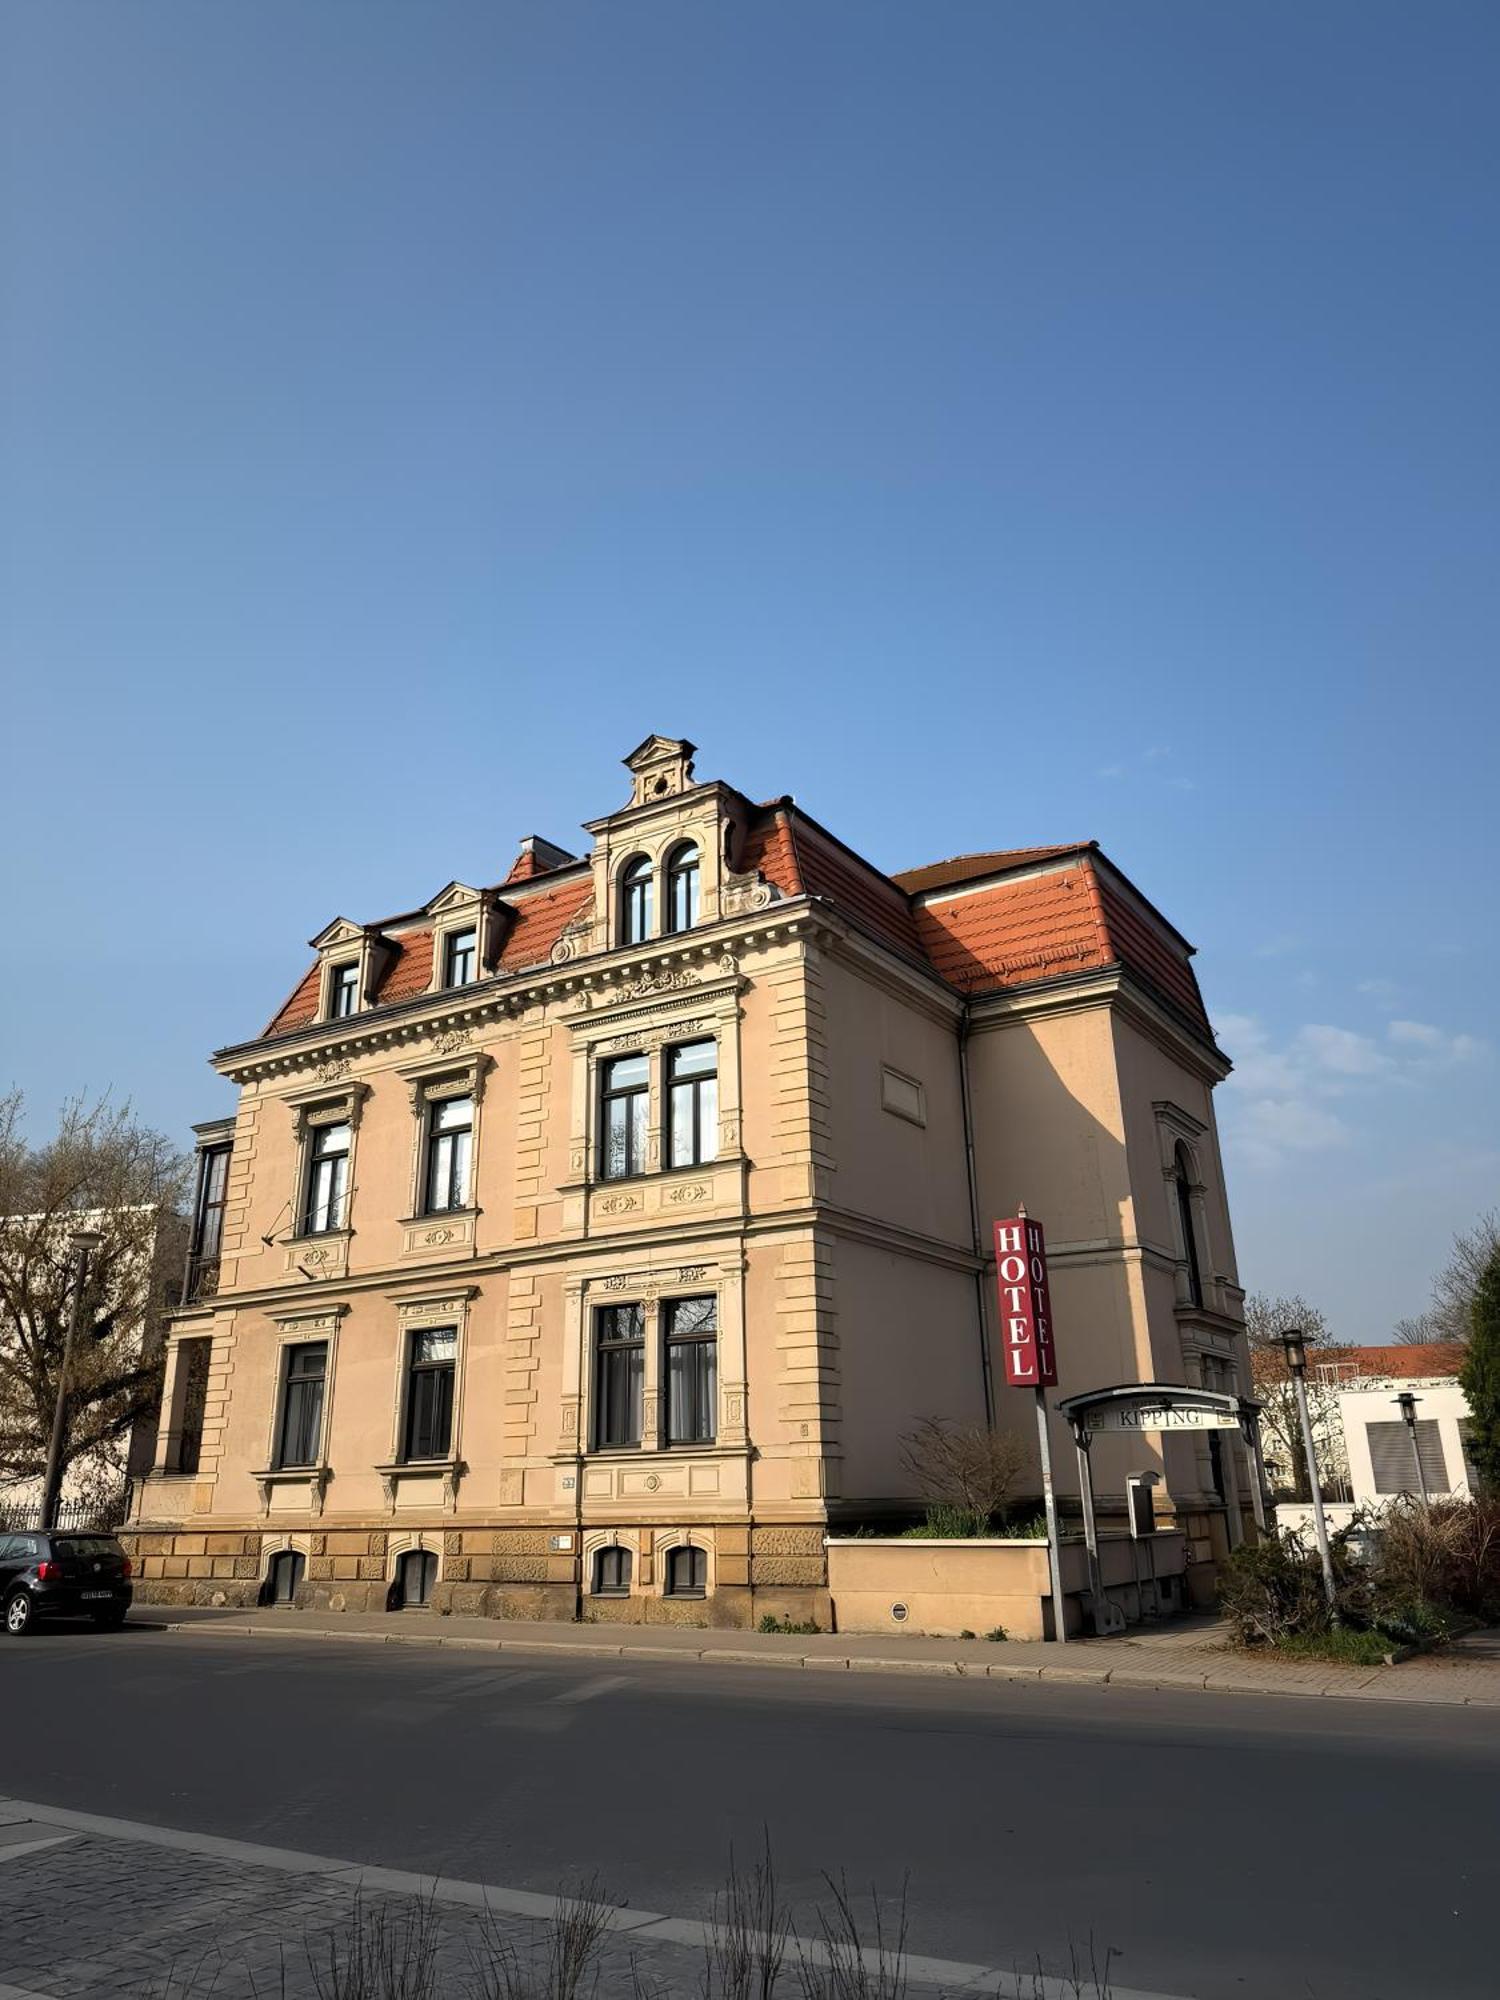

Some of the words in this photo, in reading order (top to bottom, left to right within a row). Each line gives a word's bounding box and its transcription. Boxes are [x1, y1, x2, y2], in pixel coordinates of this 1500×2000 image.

[999, 1226, 1033, 1376] HOTEL
[1028, 1227, 1053, 1376] HOTEL
[1121, 1409, 1200, 1426] KIPPING
